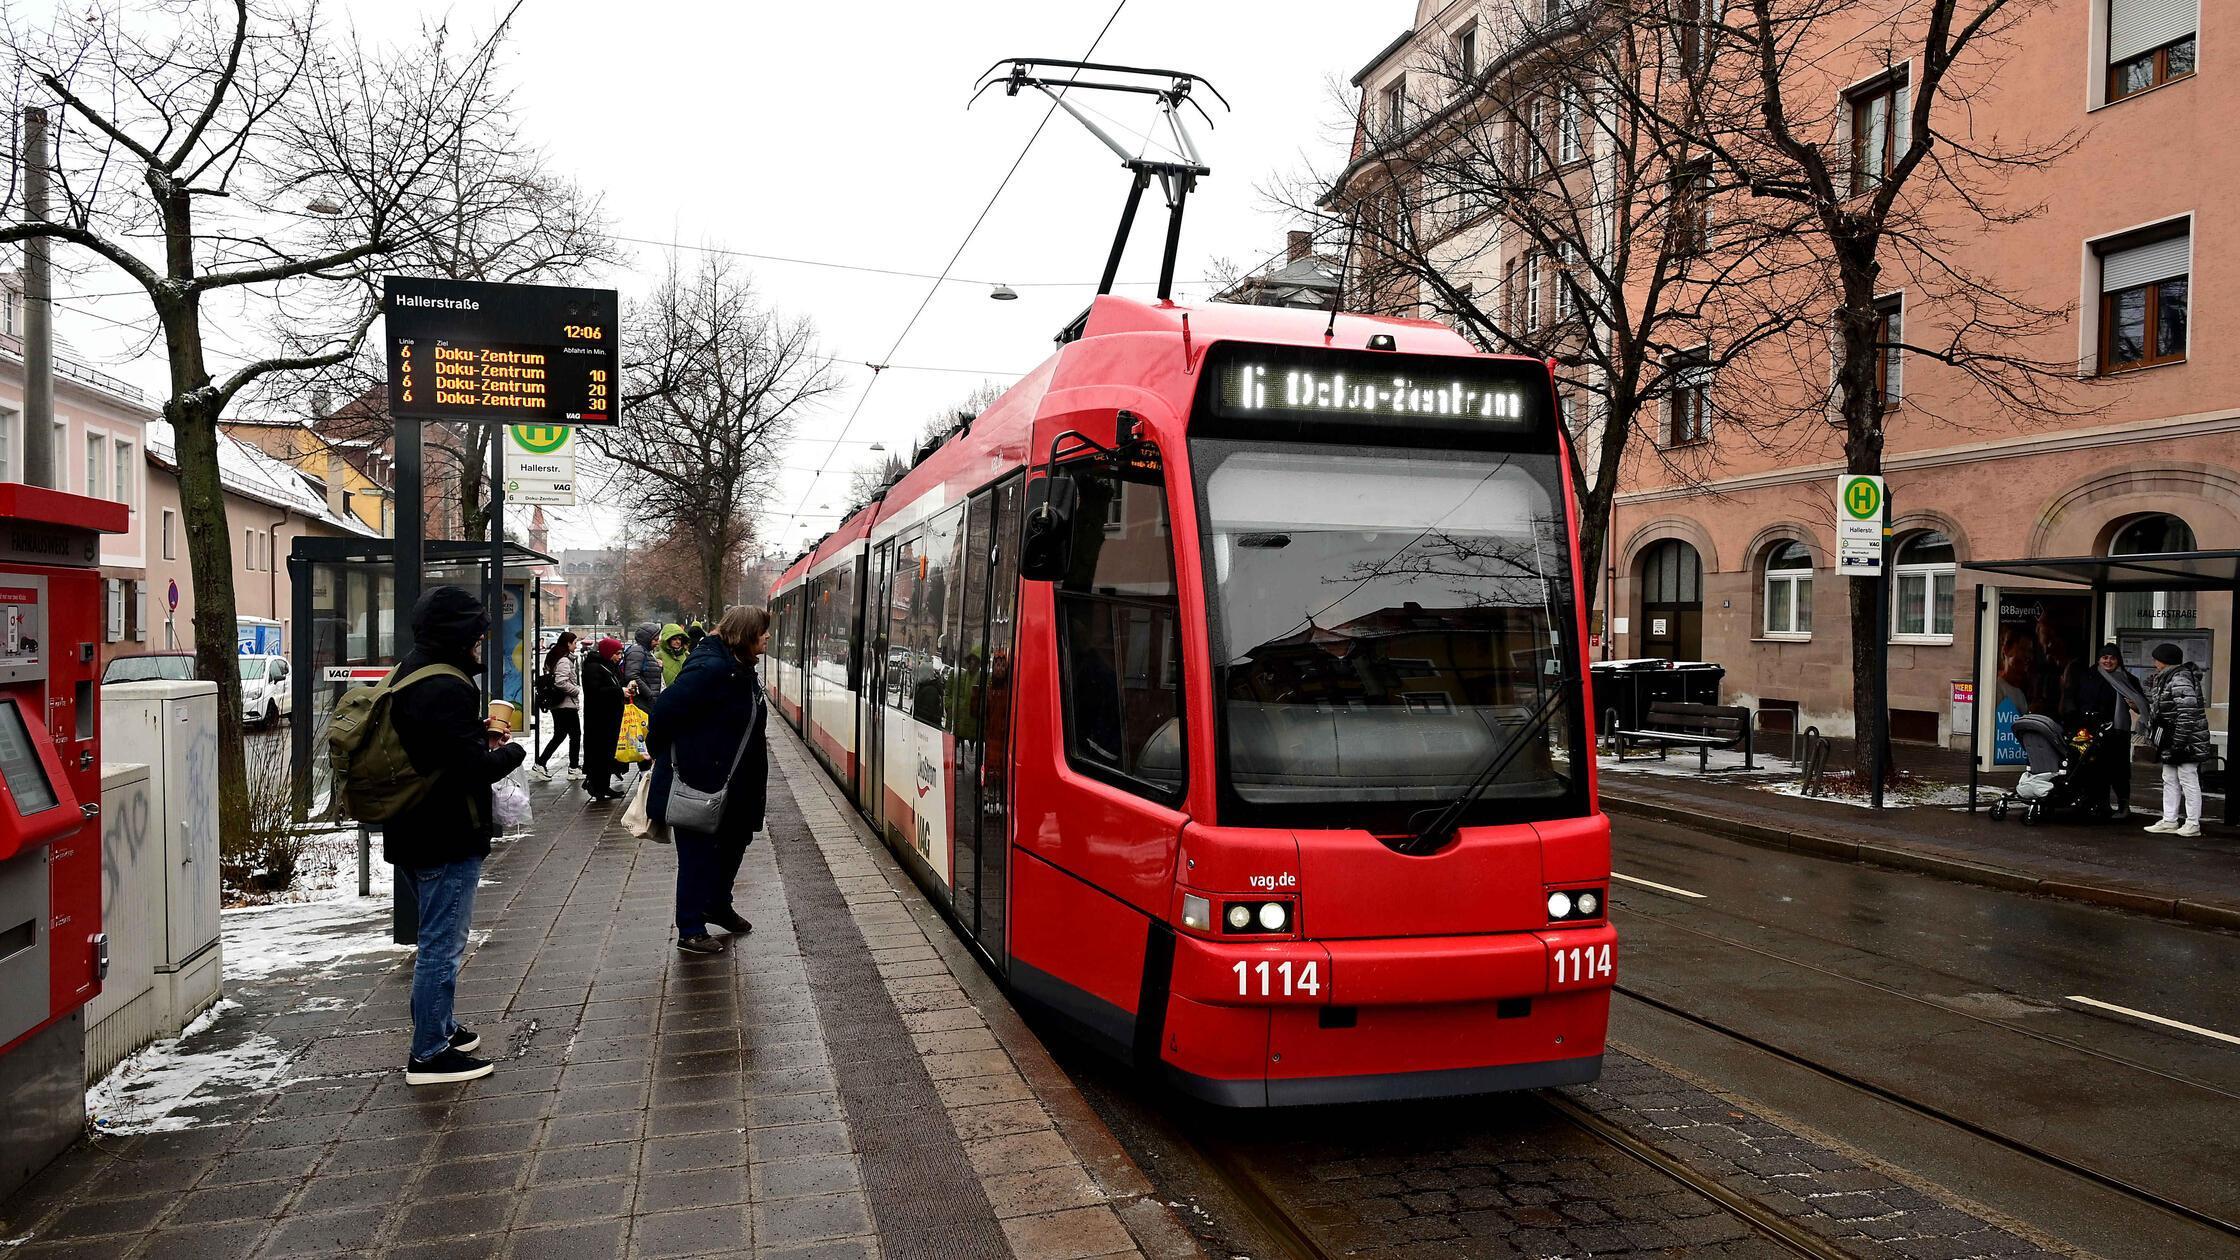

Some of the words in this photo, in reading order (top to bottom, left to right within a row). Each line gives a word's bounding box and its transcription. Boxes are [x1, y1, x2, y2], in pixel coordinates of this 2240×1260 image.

[396, 294, 480, 310] Hallerstraße
[563, 325, 602, 340] 12:06
[401, 345, 411, 358] 6
[435, 347, 545, 365] Doku-Zentrum
[563, 347, 586, 355] Abfahrt
[402, 360, 412, 373] 6
[435, 361, 545, 379] Doku-Zentrum
[589, 369, 606, 382] 10
[402, 374, 412, 388] 6
[436, 376, 546, 394] Doku-Zentrum
[588, 384, 606, 396] 20
[402, 389, 413, 402] 6
[436, 391, 546, 408] Doku-Zentrum
[588, 398, 607, 411] 30
[565, 412, 581, 420] VAG
[520, 463, 561, 473] Hallerstr.
[553, 483, 571, 492] VAG
[328, 670, 349, 678] VAG
[1997, 711, 2020, 723] Wie
[917, 813, 931, 860] VAG
[1249, 872, 1296, 890] vag.de
[1553, 944, 1612, 983] 1114
[1232, 960, 1320, 996] 1114
